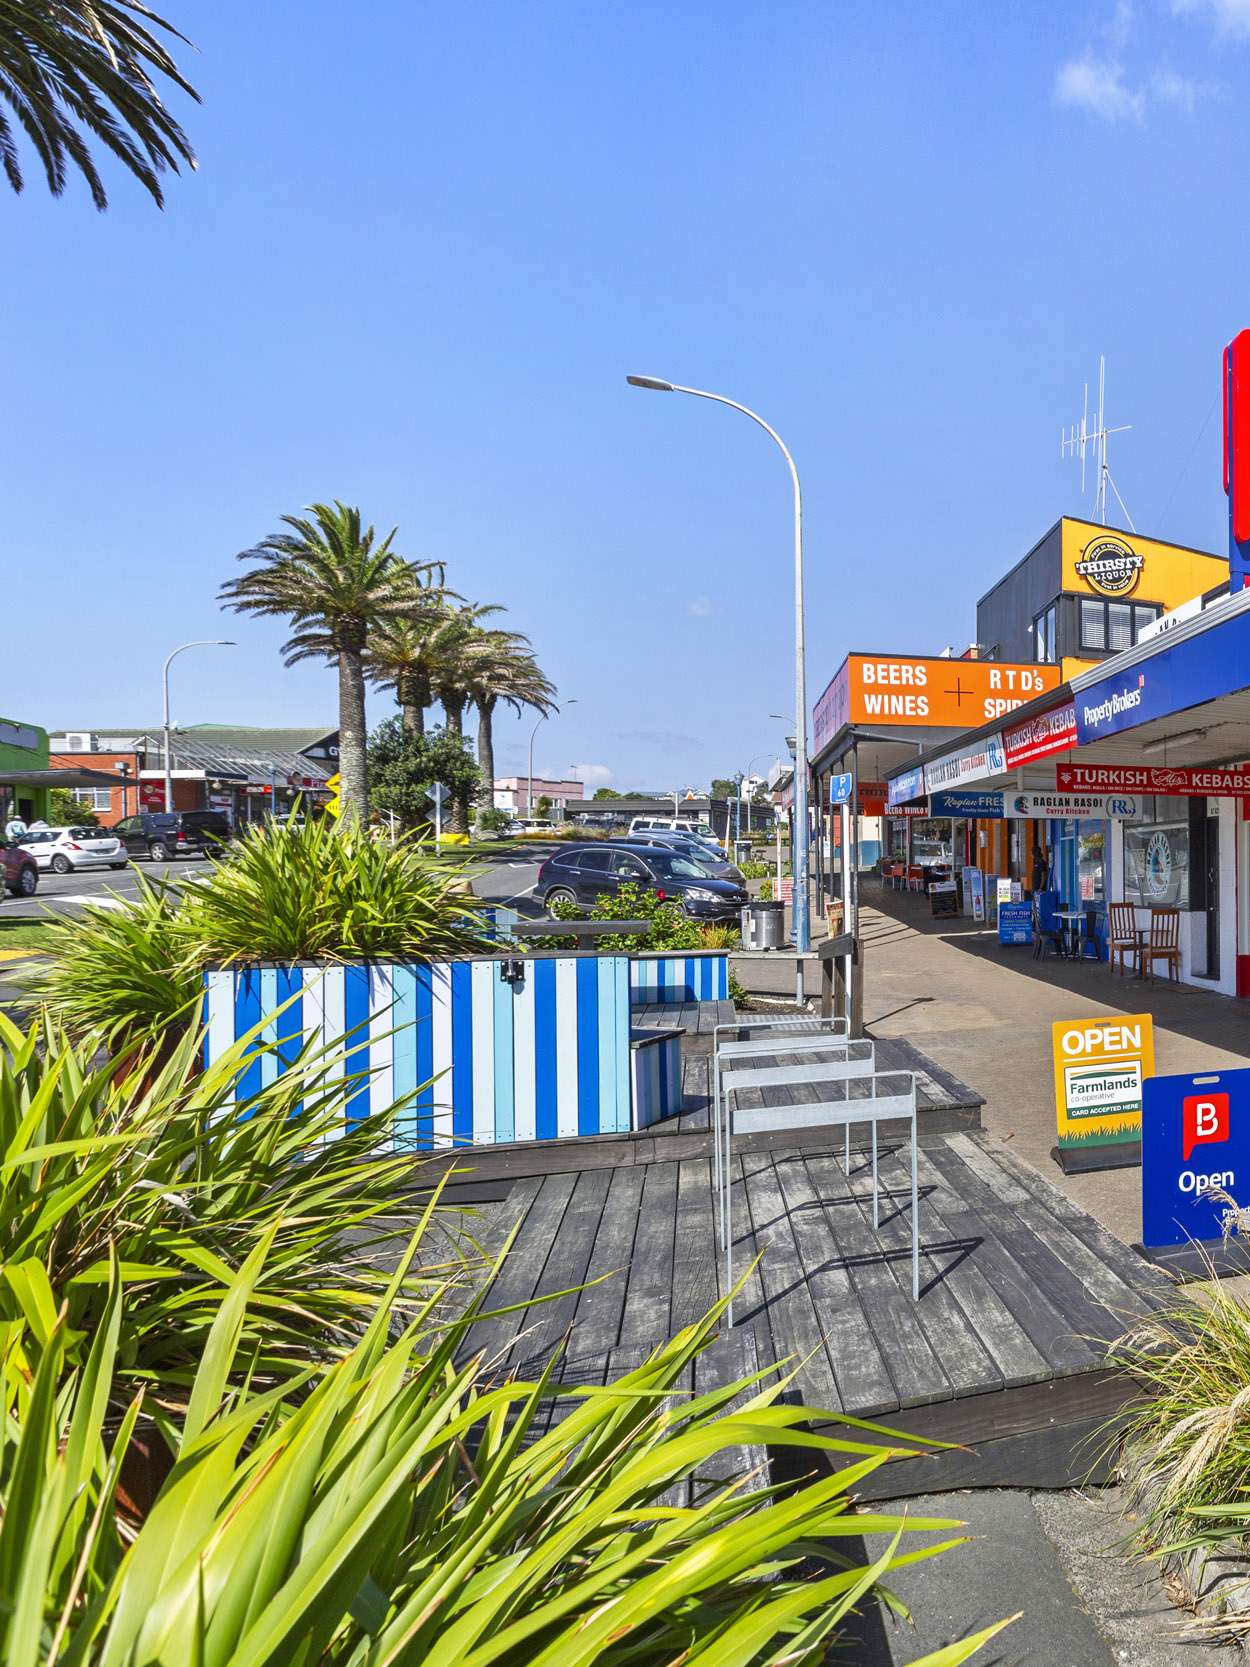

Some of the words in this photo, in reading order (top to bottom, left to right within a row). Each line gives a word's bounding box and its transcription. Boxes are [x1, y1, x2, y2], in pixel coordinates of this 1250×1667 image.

[1076, 555, 1143, 575] THIRSTY
[1094, 569, 1132, 580] LIQUOR
[862, 663, 927, 686] BEERS
[864, 694, 929, 716] WINES
[1006, 726, 1033, 752] TURKISH
[840, 778, 847, 787] P
[1073, 768, 1147, 784] TURKISH
[838, 789, 845, 797] 60
[944, 795, 977, 808] Raglan
[1033, 797, 1071, 807] RAGLAN
[1074, 797, 1103, 808] RASOI
[1046, 807, 1064, 815] Curry
[1065, 807, 1090, 815] Kitchen
[1062, 1024, 1142, 1056] OPEN
[1070, 1077, 1137, 1094] Farmlands
[1071, 1092, 1115, 1103] co-operative
[1090, 1105, 1121, 1114] ACCEPTED
[1196, 1102, 1219, 1137] B
[1178, 1170, 1234, 1196] Open
